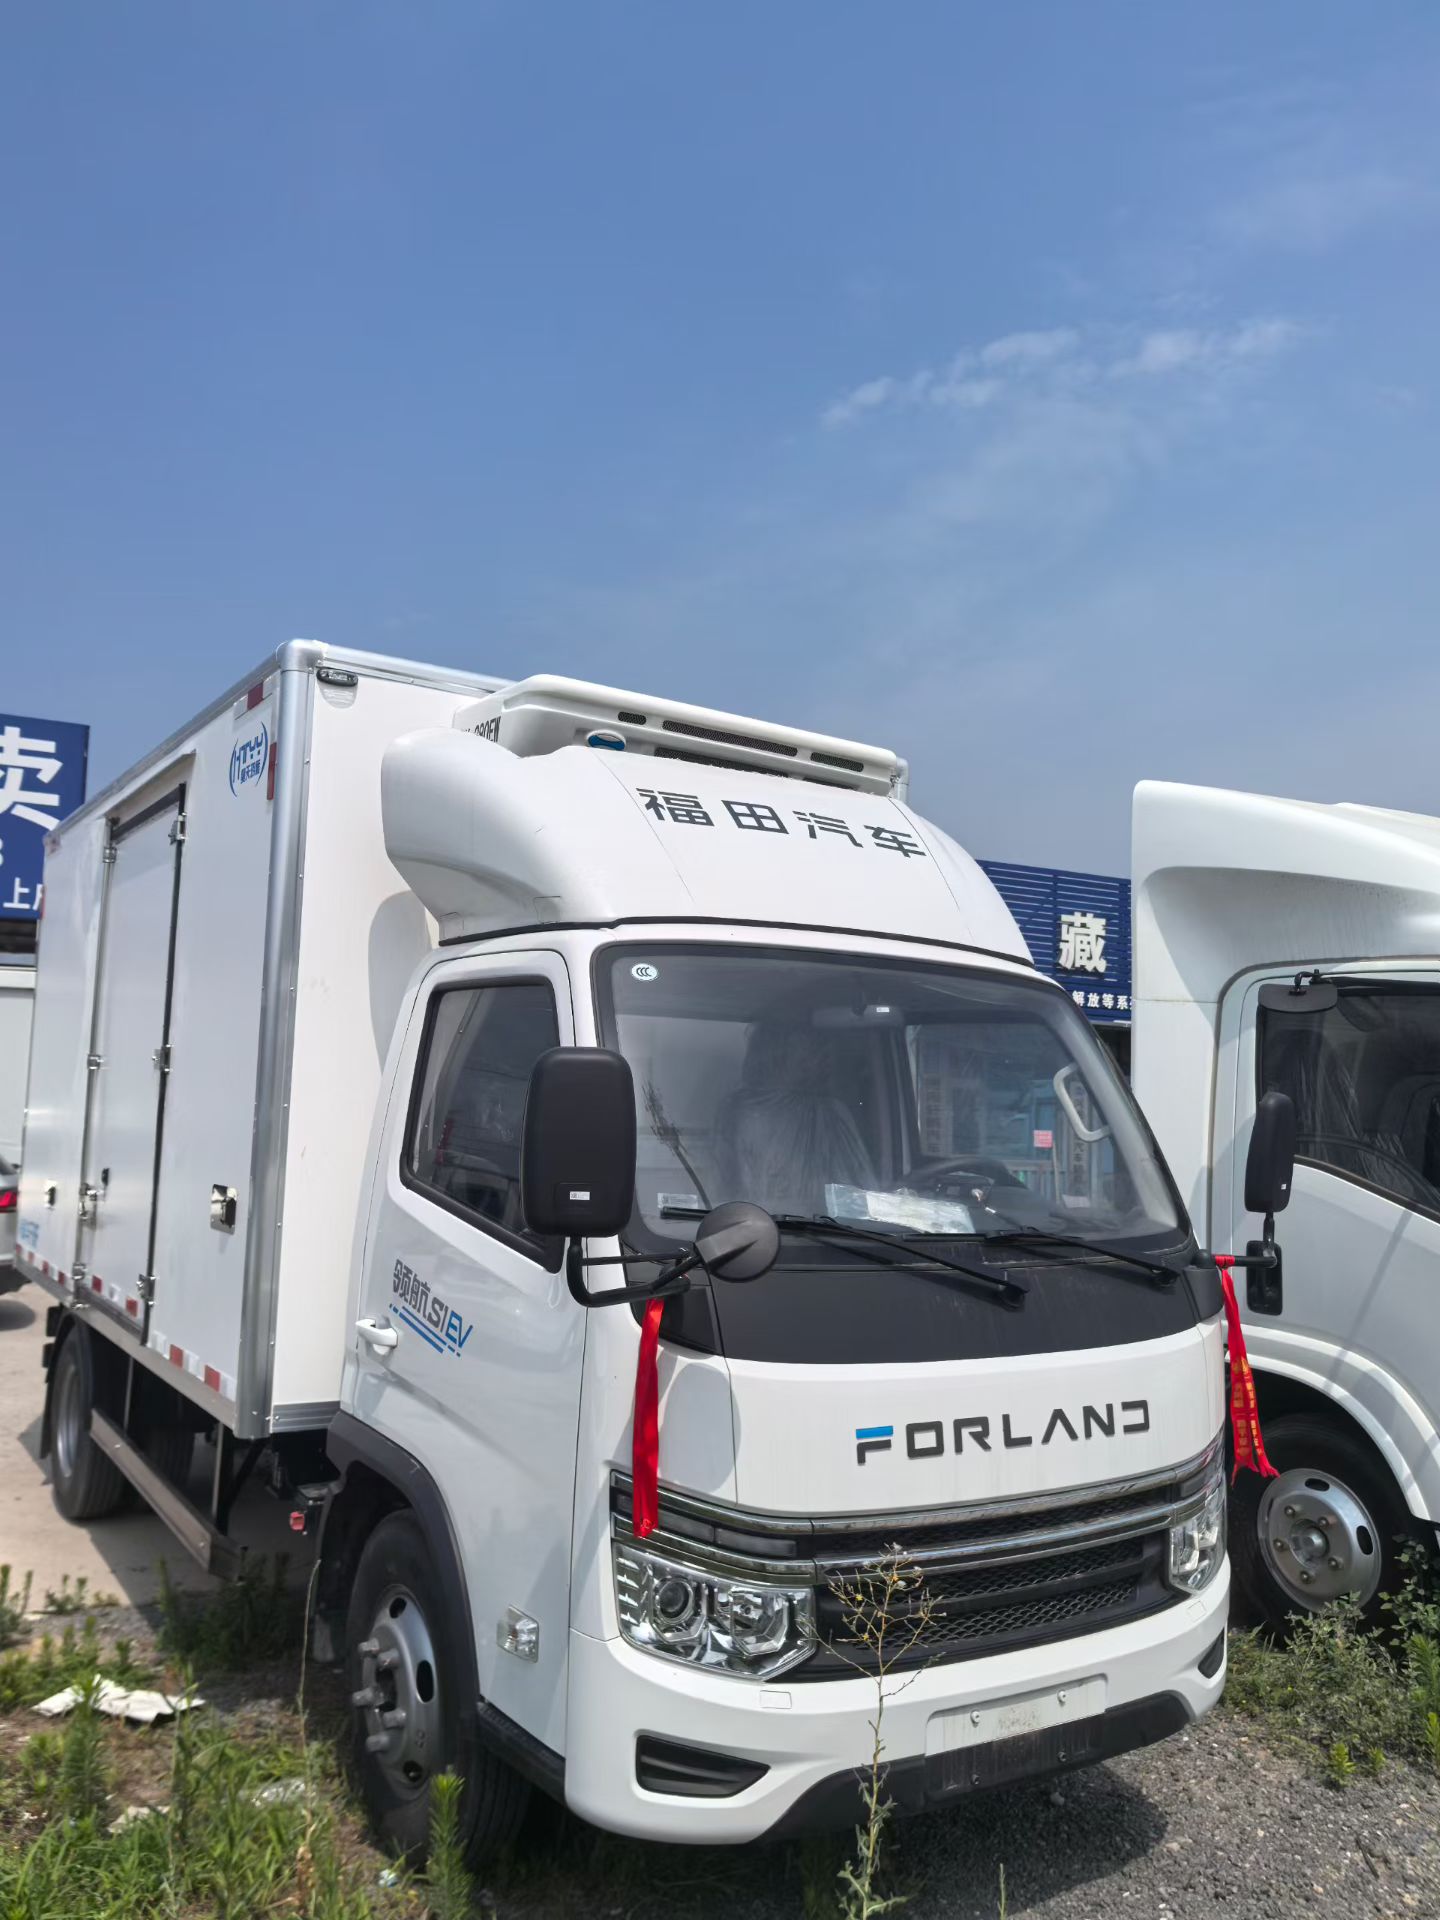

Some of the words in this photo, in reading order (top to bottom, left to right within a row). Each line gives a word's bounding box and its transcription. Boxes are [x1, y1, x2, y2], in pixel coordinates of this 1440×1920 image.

[635, 787, 927, 859] 福田汽车
[1058, 911, 1107, 974] 藏
[1072, 989, 1131, 1011] 解放等系
[856, 1399, 1150, 1465] FORLAND
